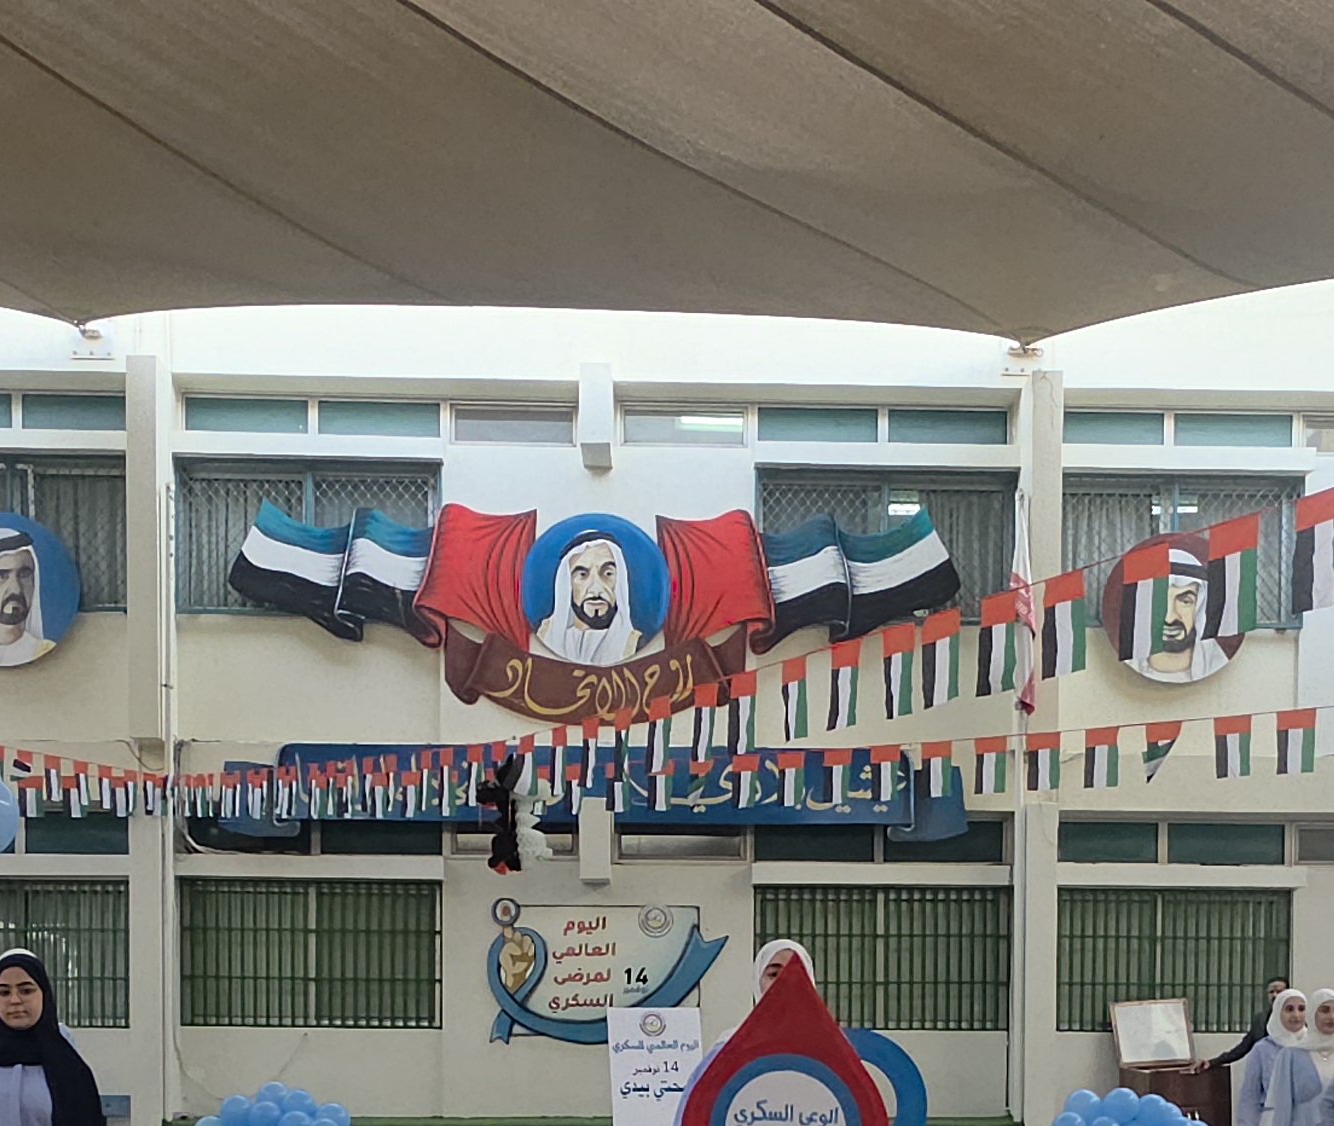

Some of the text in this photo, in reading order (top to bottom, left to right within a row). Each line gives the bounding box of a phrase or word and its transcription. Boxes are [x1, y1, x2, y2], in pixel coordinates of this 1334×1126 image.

[562, 916, 607, 937] اليوم
[551, 942, 617, 964] العالمي
[553, 967, 612, 986] لمرضى
[623, 966, 649, 985] 14
[548, 993, 614, 1014] السكري
[646, 1039, 679, 1054] العالمي
[679, 1039, 700, 1052] اليوم
[632, 1060, 679, 1076] 14 نوفمبر
[619, 1080, 685, 1102] حتي بيدي
